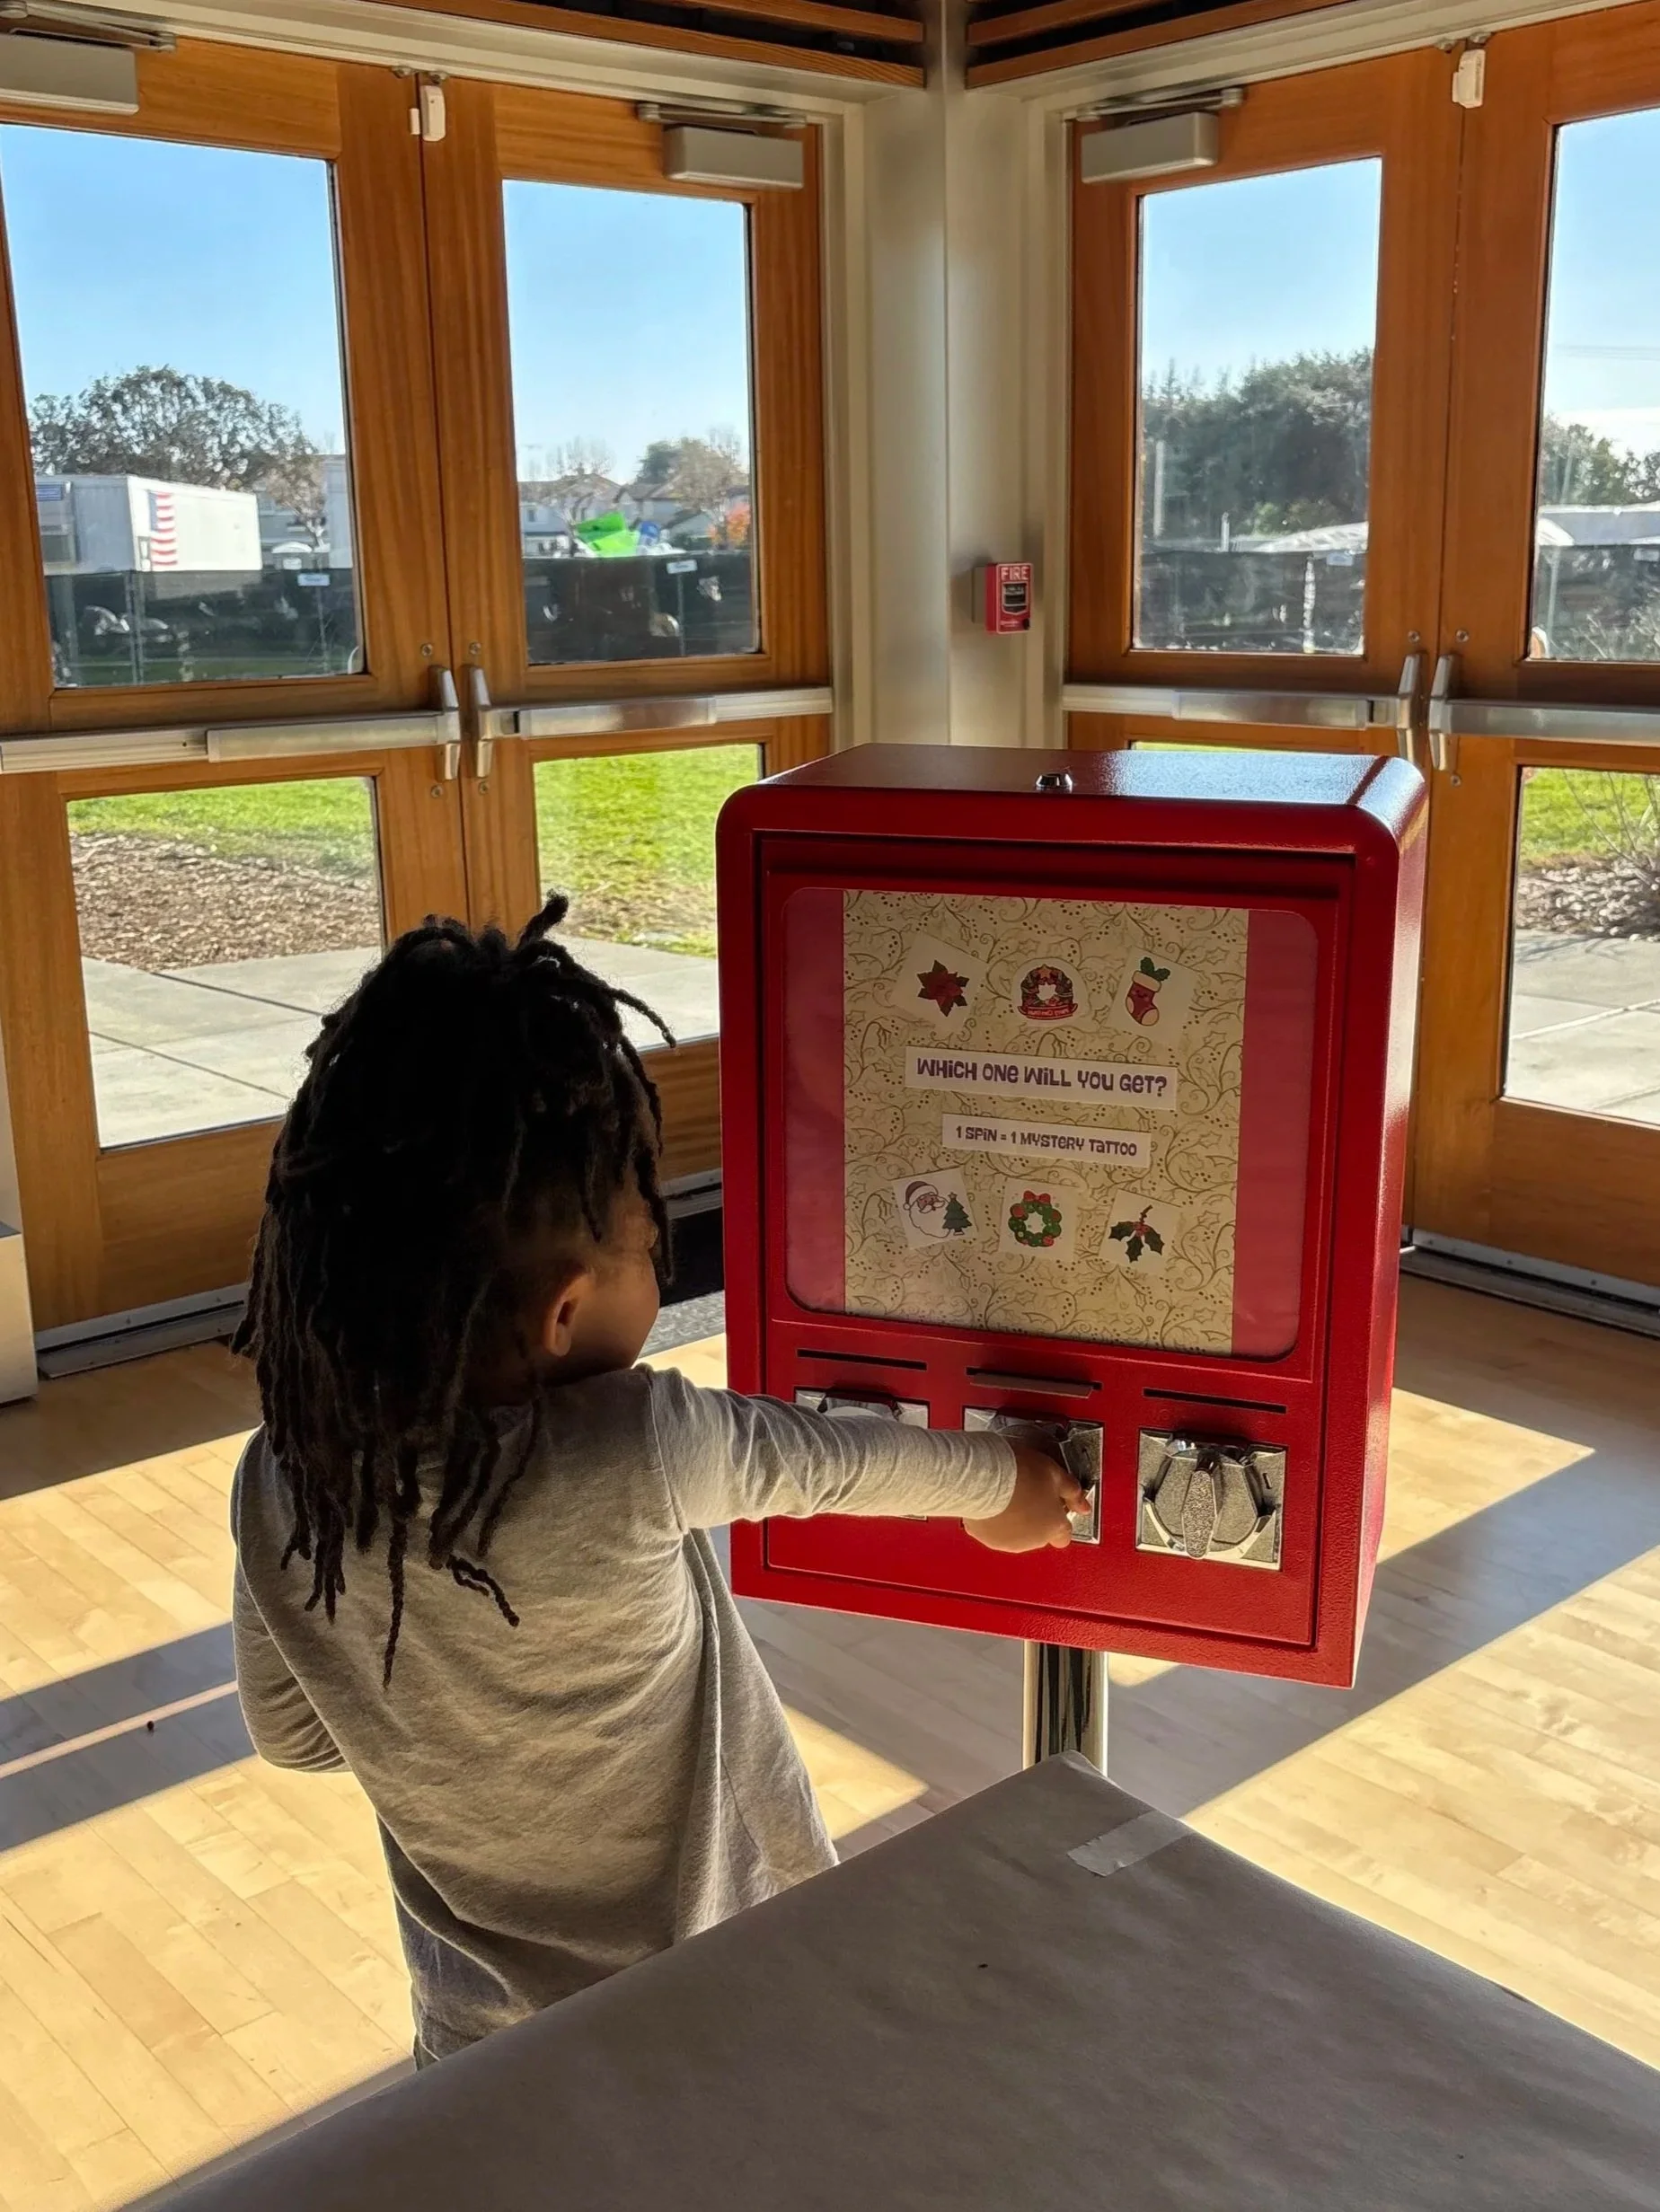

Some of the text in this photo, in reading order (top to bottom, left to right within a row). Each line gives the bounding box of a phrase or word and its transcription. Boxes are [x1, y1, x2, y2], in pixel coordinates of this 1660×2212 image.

[1001, 567, 1029, 581] FIRE
[956, 1125, 962, 1139] 1
[1011, 1132, 1017, 1144] 1
